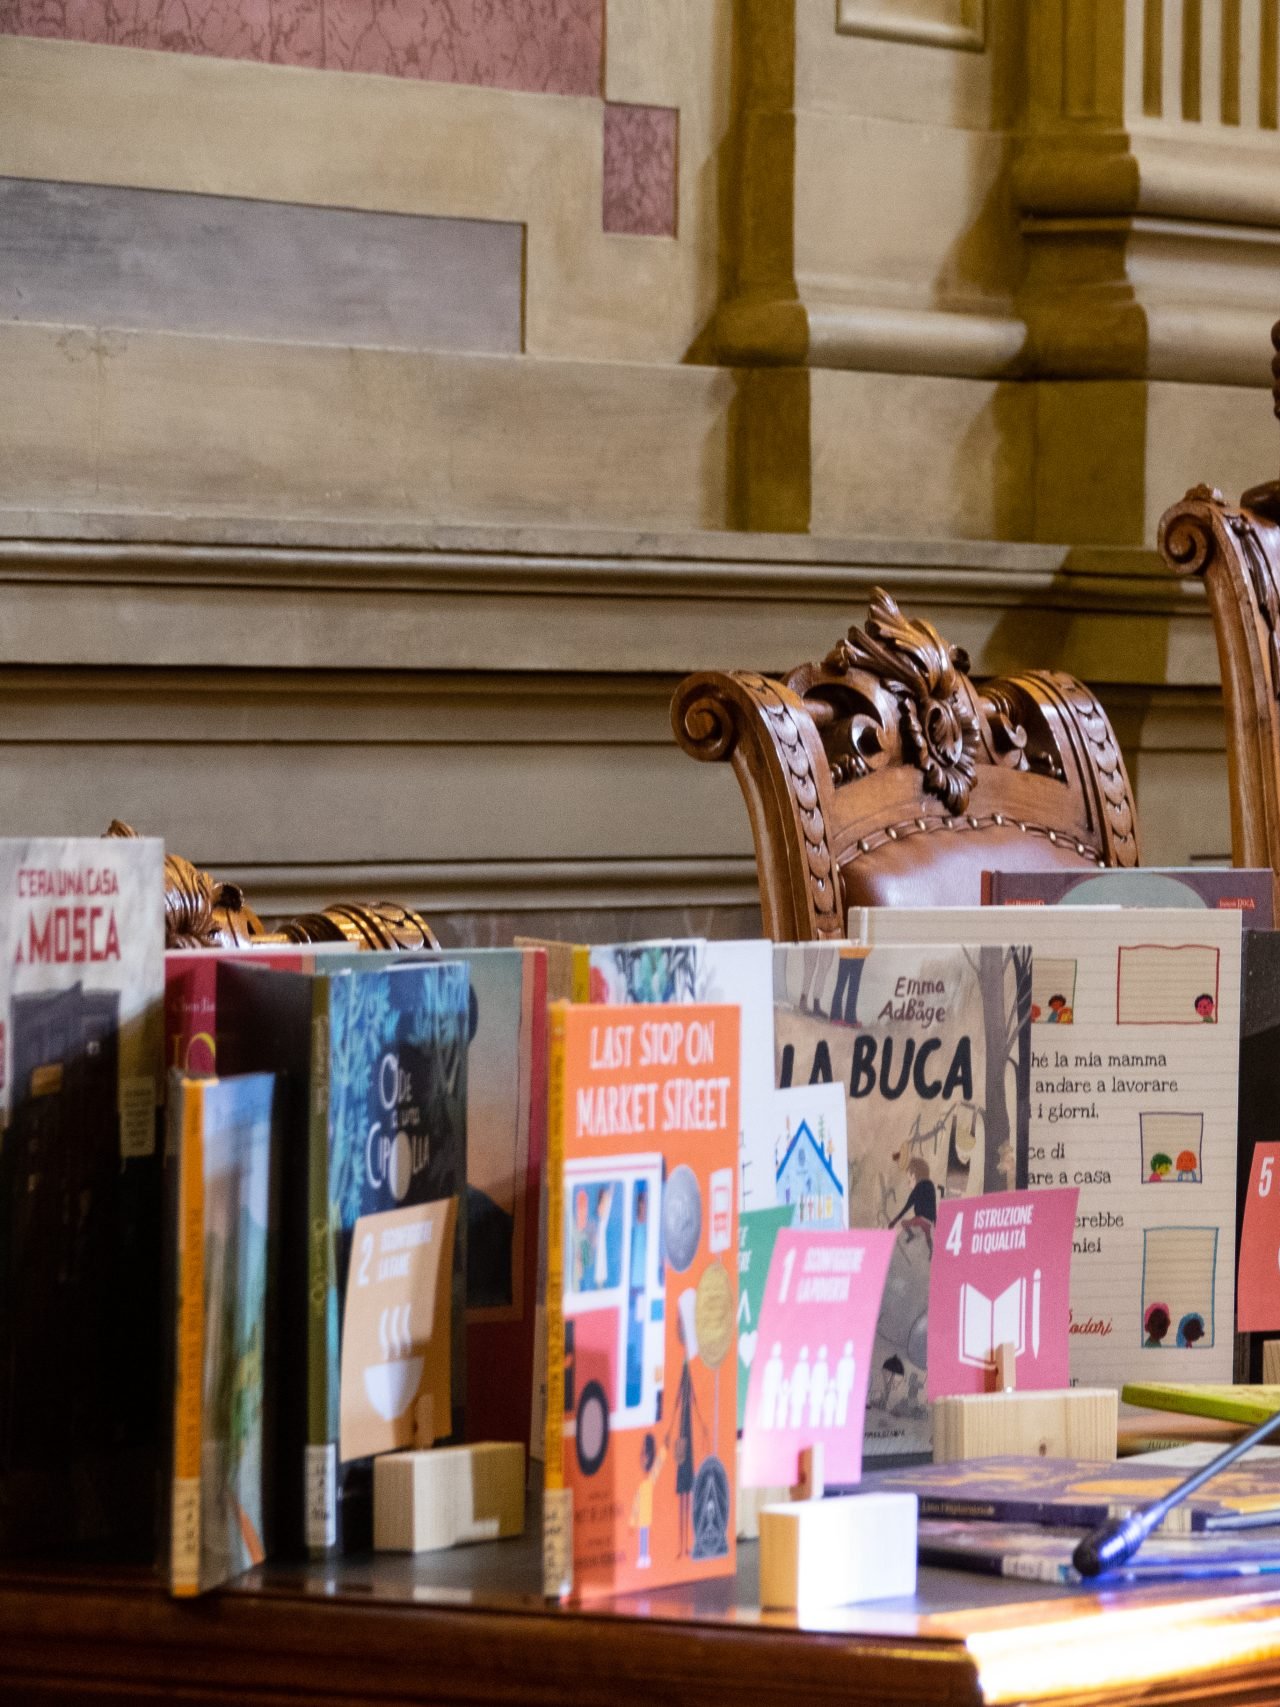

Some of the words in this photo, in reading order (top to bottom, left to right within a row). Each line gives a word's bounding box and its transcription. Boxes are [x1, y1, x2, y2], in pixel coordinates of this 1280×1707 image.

[57, 868, 84, 897] UNA
[87, 867, 120, 897] CASA
[29, 905, 122, 965] MOSCA
[894, 976, 946, 998] Emma
[589, 1024, 635, 1071] LAST
[639, 1020, 685, 1067] STOP
[685, 1019, 716, 1067] ON
[1055, 1051, 1069, 1068] la
[1074, 1051, 1102, 1068] mia
[1108, 1053, 1168, 1068] mamma
[849, 1033, 974, 1101] BUCA
[1035, 1077, 1092, 1094] andare
[1097, 1080, 1106, 1093] a
[1112, 1076, 1179, 1093] lavorare
[575, 1081, 660, 1139] MARKET
[661, 1076, 732, 1132] STREET
[1051, 1142, 1065, 1160] di
[1059, 1171, 1069, 1184] a
[1073, 1170, 1112, 1185] casa
[1258, 1156, 1275, 1198] 5
[945, 1211, 965, 1257] 4
[973, 1204, 1035, 1231] ISTRUZIONE
[970, 1234, 985, 1255] DI
[984, 1226, 1028, 1255] QUALITÀ
[356, 1231, 375, 1288] 2
[777, 1247, 797, 1305] 1
